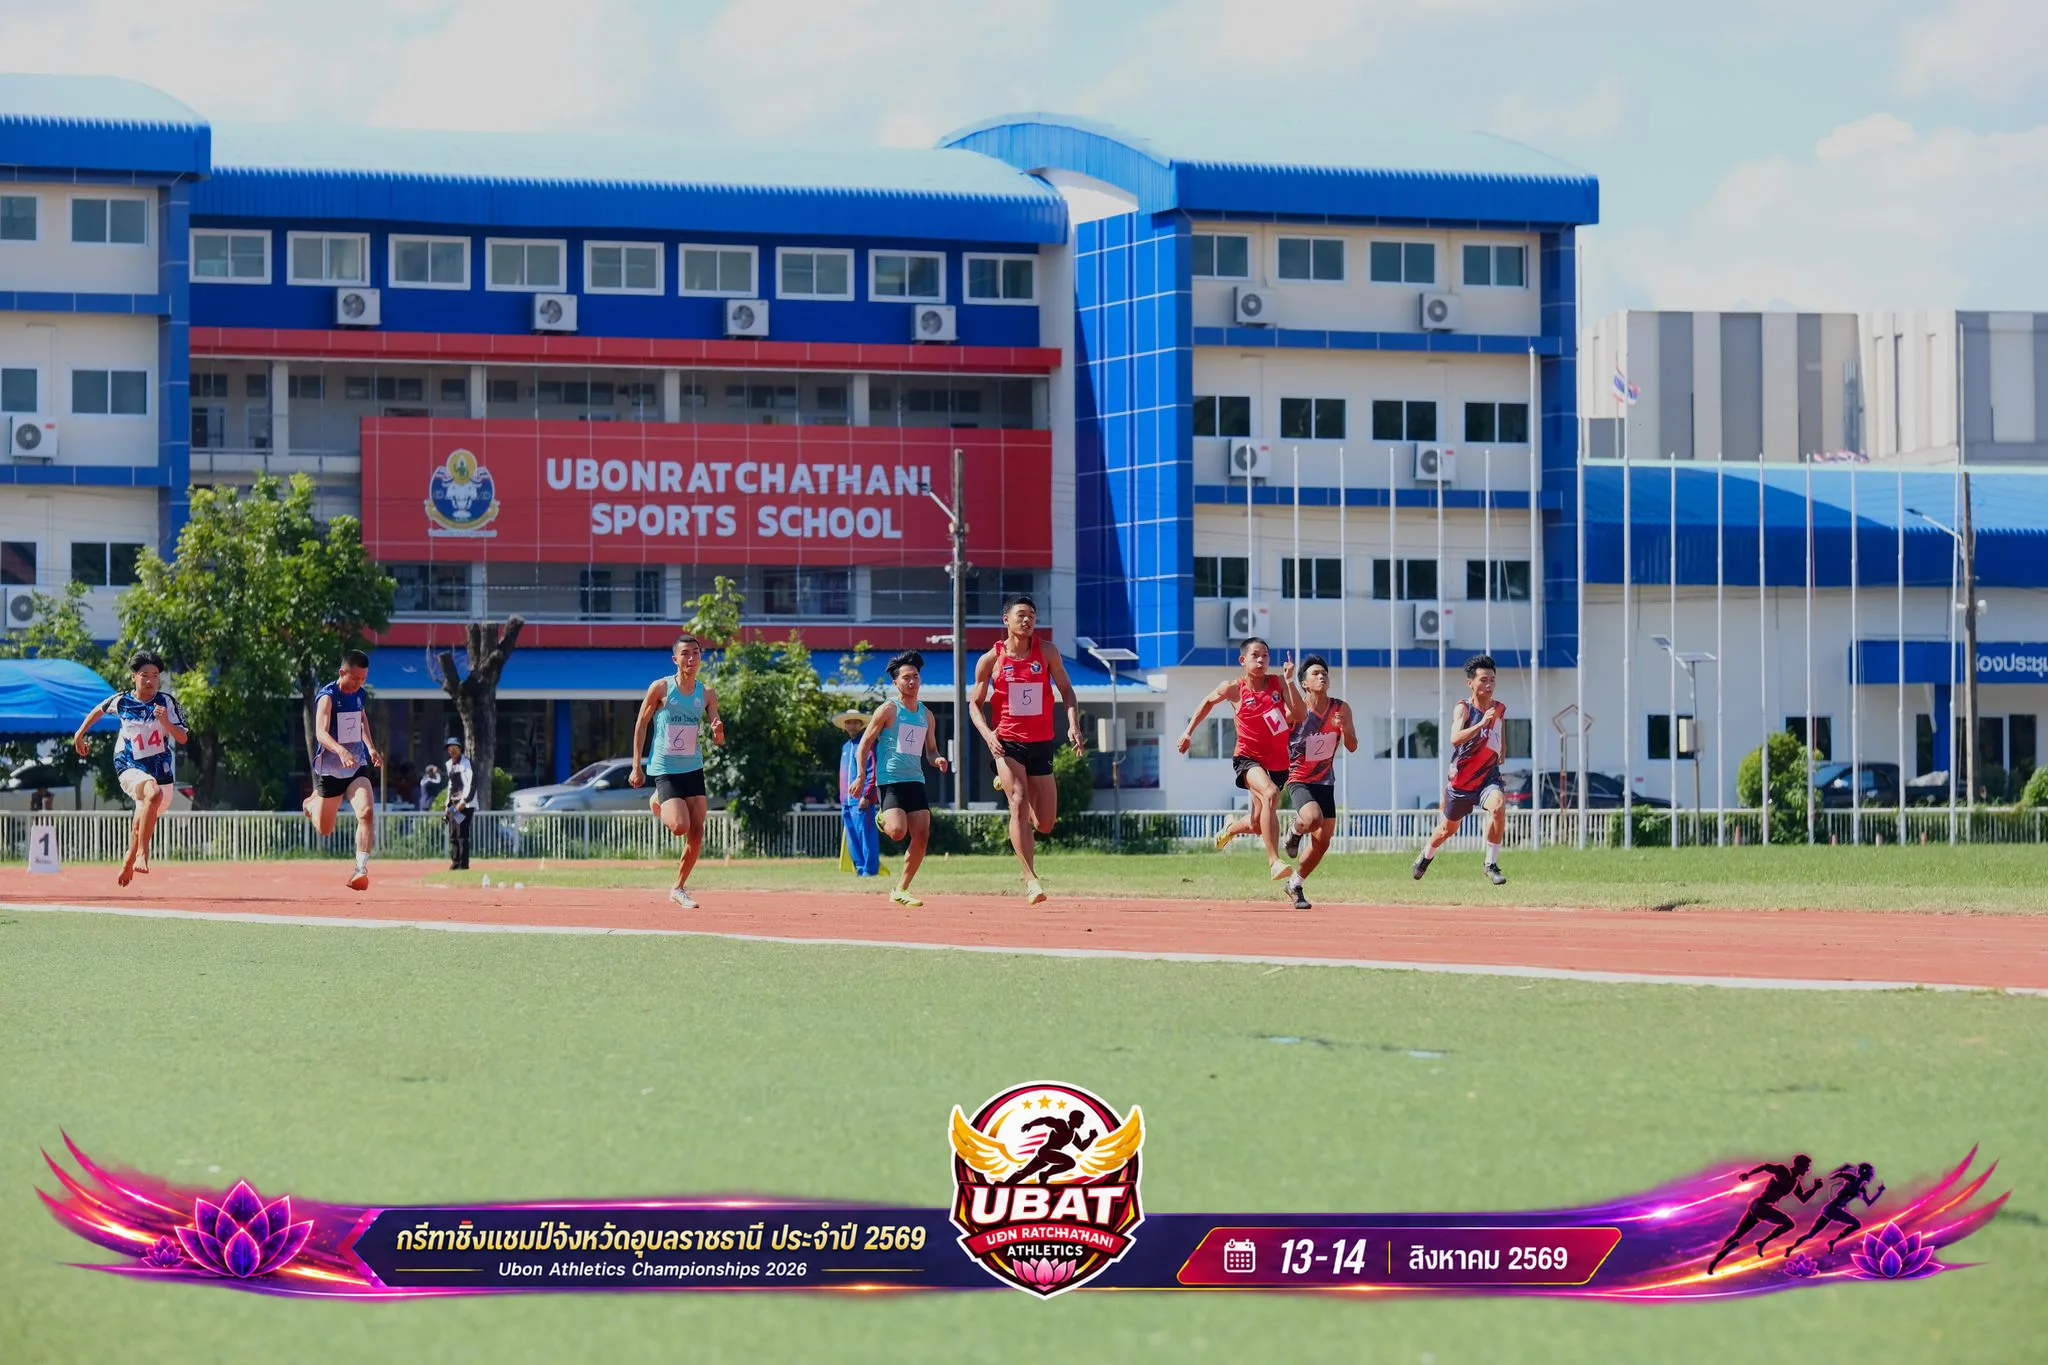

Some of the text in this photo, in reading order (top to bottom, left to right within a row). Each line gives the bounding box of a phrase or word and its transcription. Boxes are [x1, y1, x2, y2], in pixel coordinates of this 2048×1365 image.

[546, 458, 931, 497] UBONRATCHATHANI
[592, 503, 902, 539] SPORTS SCHOOL
[1021, 688, 1033, 706] 5
[133, 729, 162, 751] 14
[673, 728, 685, 749] 6
[905, 728, 917, 747] 4
[1313, 739, 1325, 756] 2
[38, 832, 50, 857] 1
